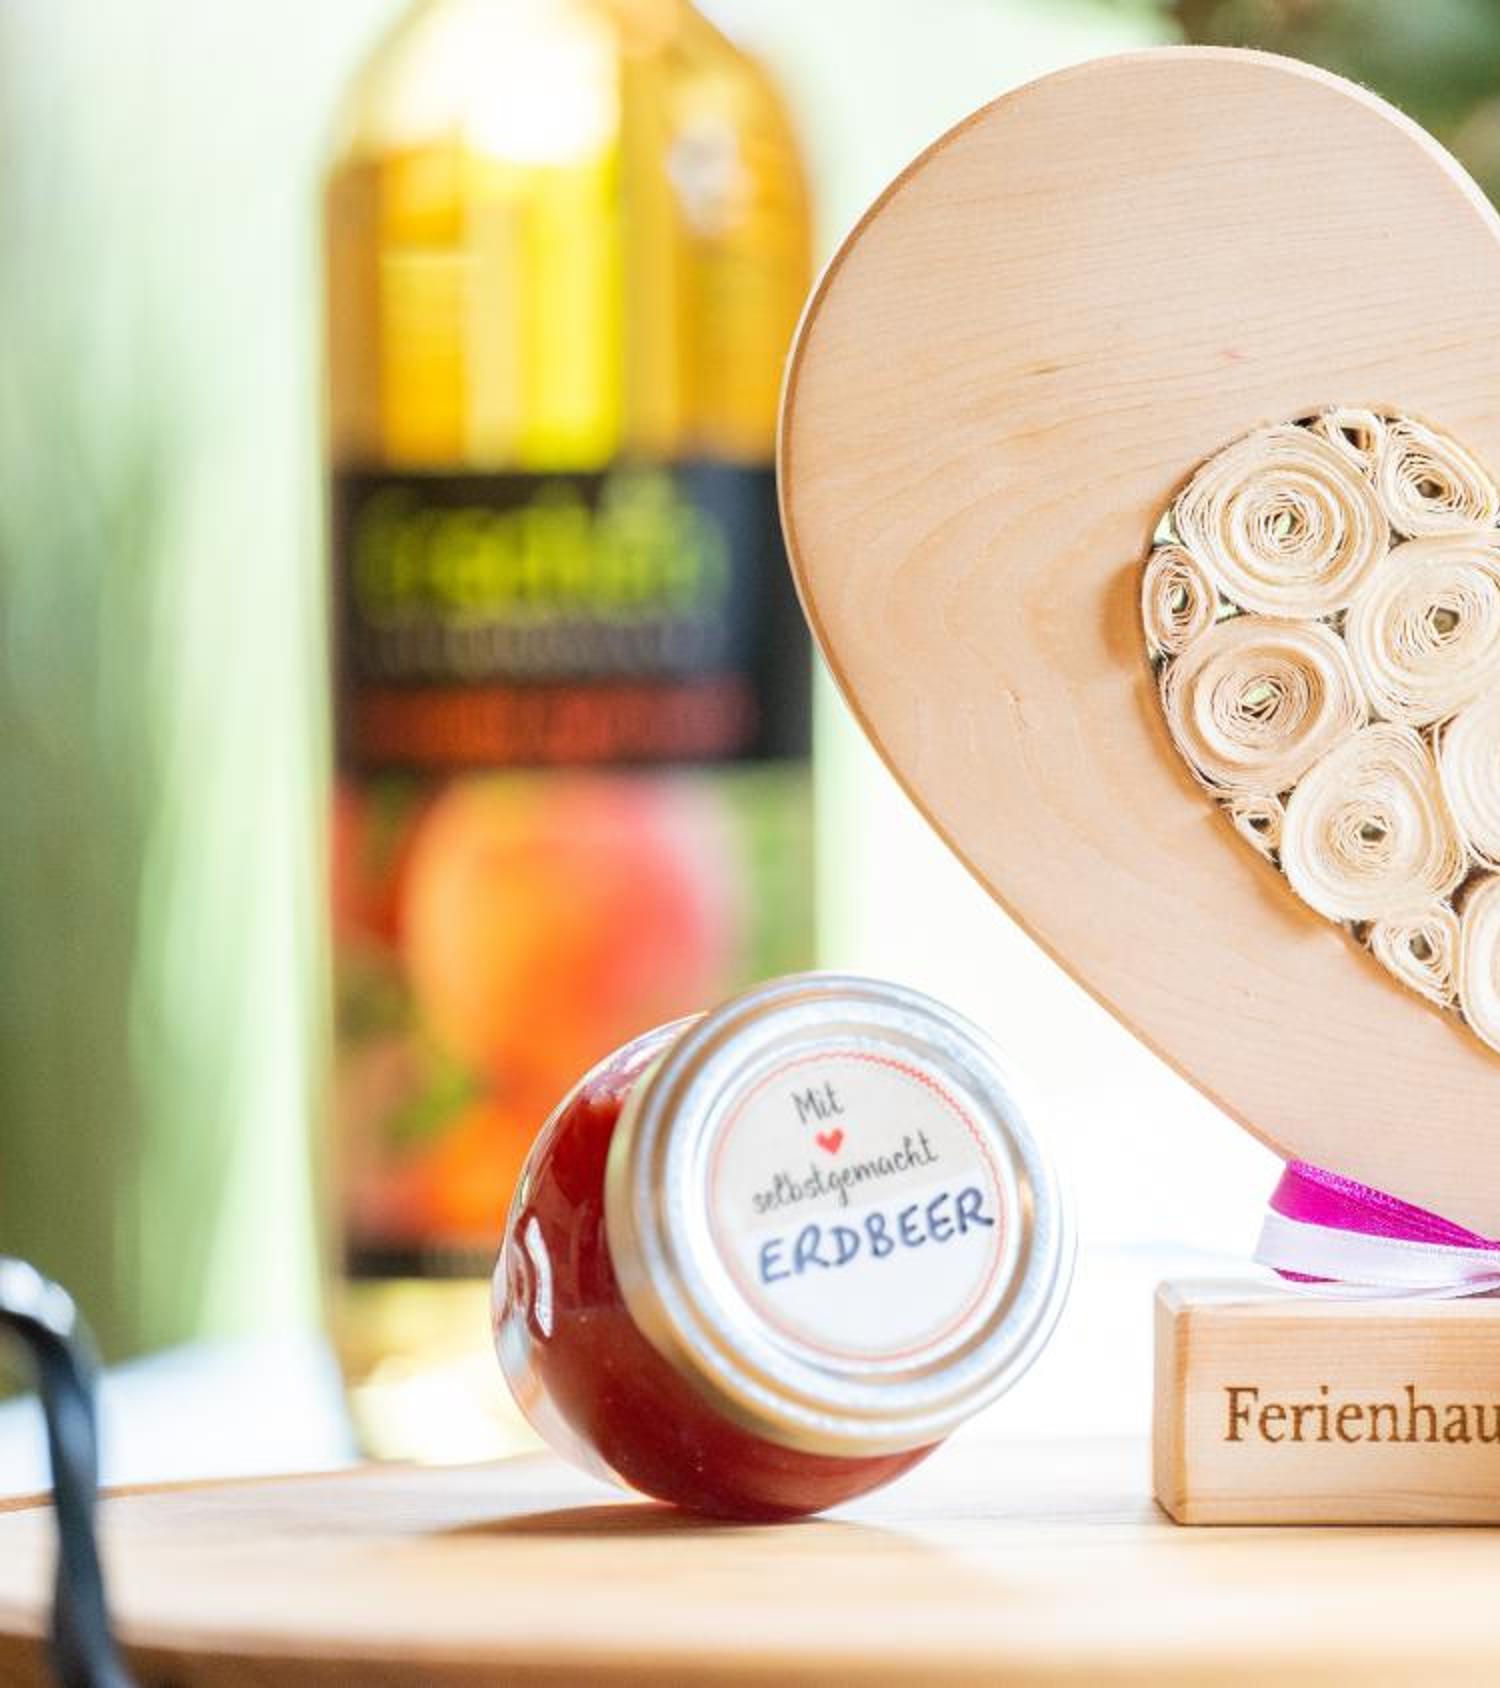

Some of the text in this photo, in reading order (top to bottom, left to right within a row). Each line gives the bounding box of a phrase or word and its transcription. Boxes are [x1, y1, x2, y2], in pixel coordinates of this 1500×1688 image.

[792, 1082, 844, 1125] Mit
[753, 1130, 938, 1214] selbstgemacht
[759, 1186, 995, 1284] ERDBEER
